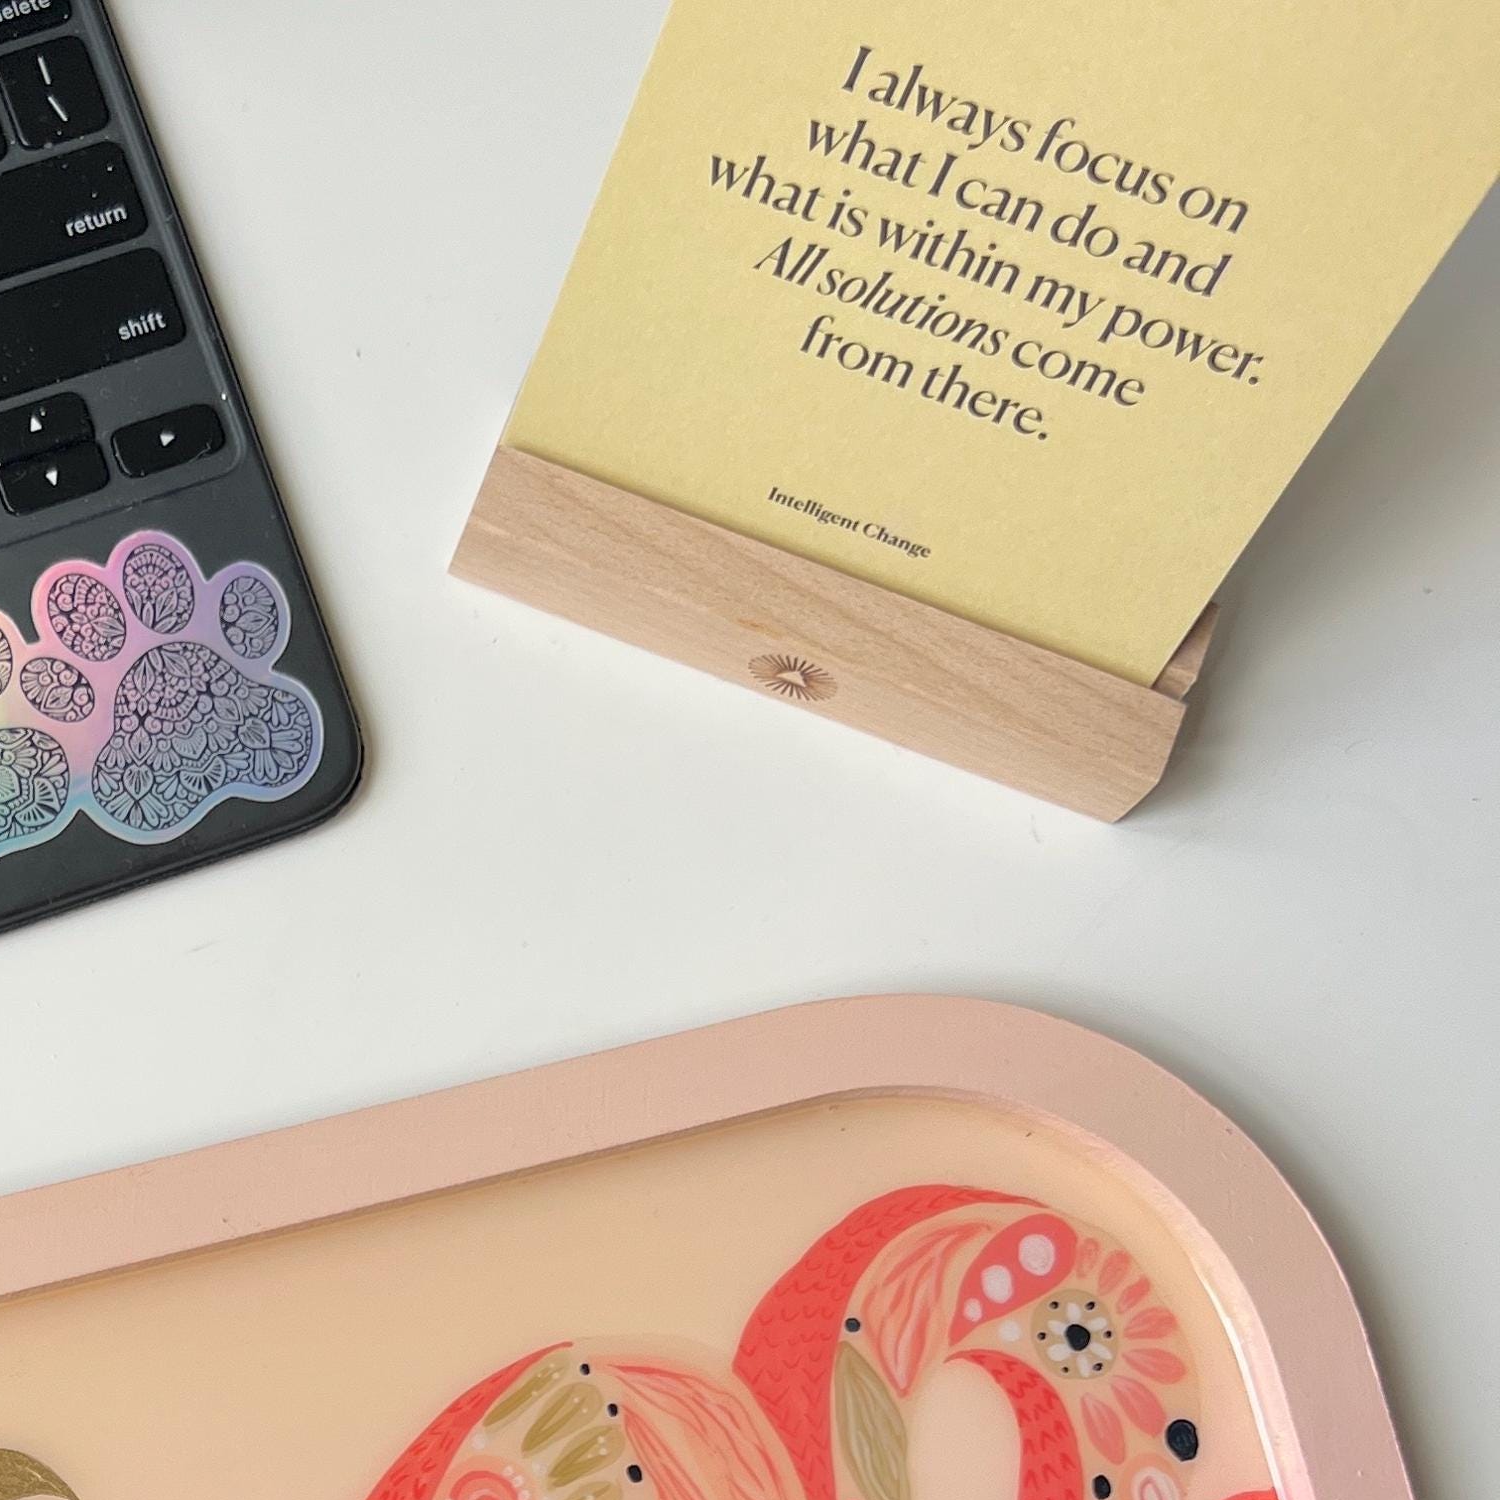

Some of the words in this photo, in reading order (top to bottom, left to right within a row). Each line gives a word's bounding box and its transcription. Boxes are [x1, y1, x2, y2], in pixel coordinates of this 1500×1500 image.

[808, 118, 927, 189] what
[927, 152, 959, 197] I
[955, 177, 1045, 235] can
[1050, 203, 1120, 258] do
[1122, 241, 1233, 297] and
[841, 45, 873, 93] I
[865, 64, 1033, 153] always
[1034, 116, 1176, 205] focus
[1178, 186, 1249, 234] on
[65, 206, 127, 237] return
[709, 153, 826, 223] what
[826, 188, 869, 238] is
[876, 215, 1022, 296] within
[1024, 273, 1106, 330] my
[1097, 303, 1265, 388] power.
[118, 312, 166, 341] shift
[753, 235, 829, 286] All
[815, 270, 1011, 359] solutions
[1010, 339, 1147, 409] come
[799, 313, 916, 390] from
[920, 362, 1051, 442] there.
[767, 485, 862, 534] Intelligent
[862, 522, 931, 558] Change
